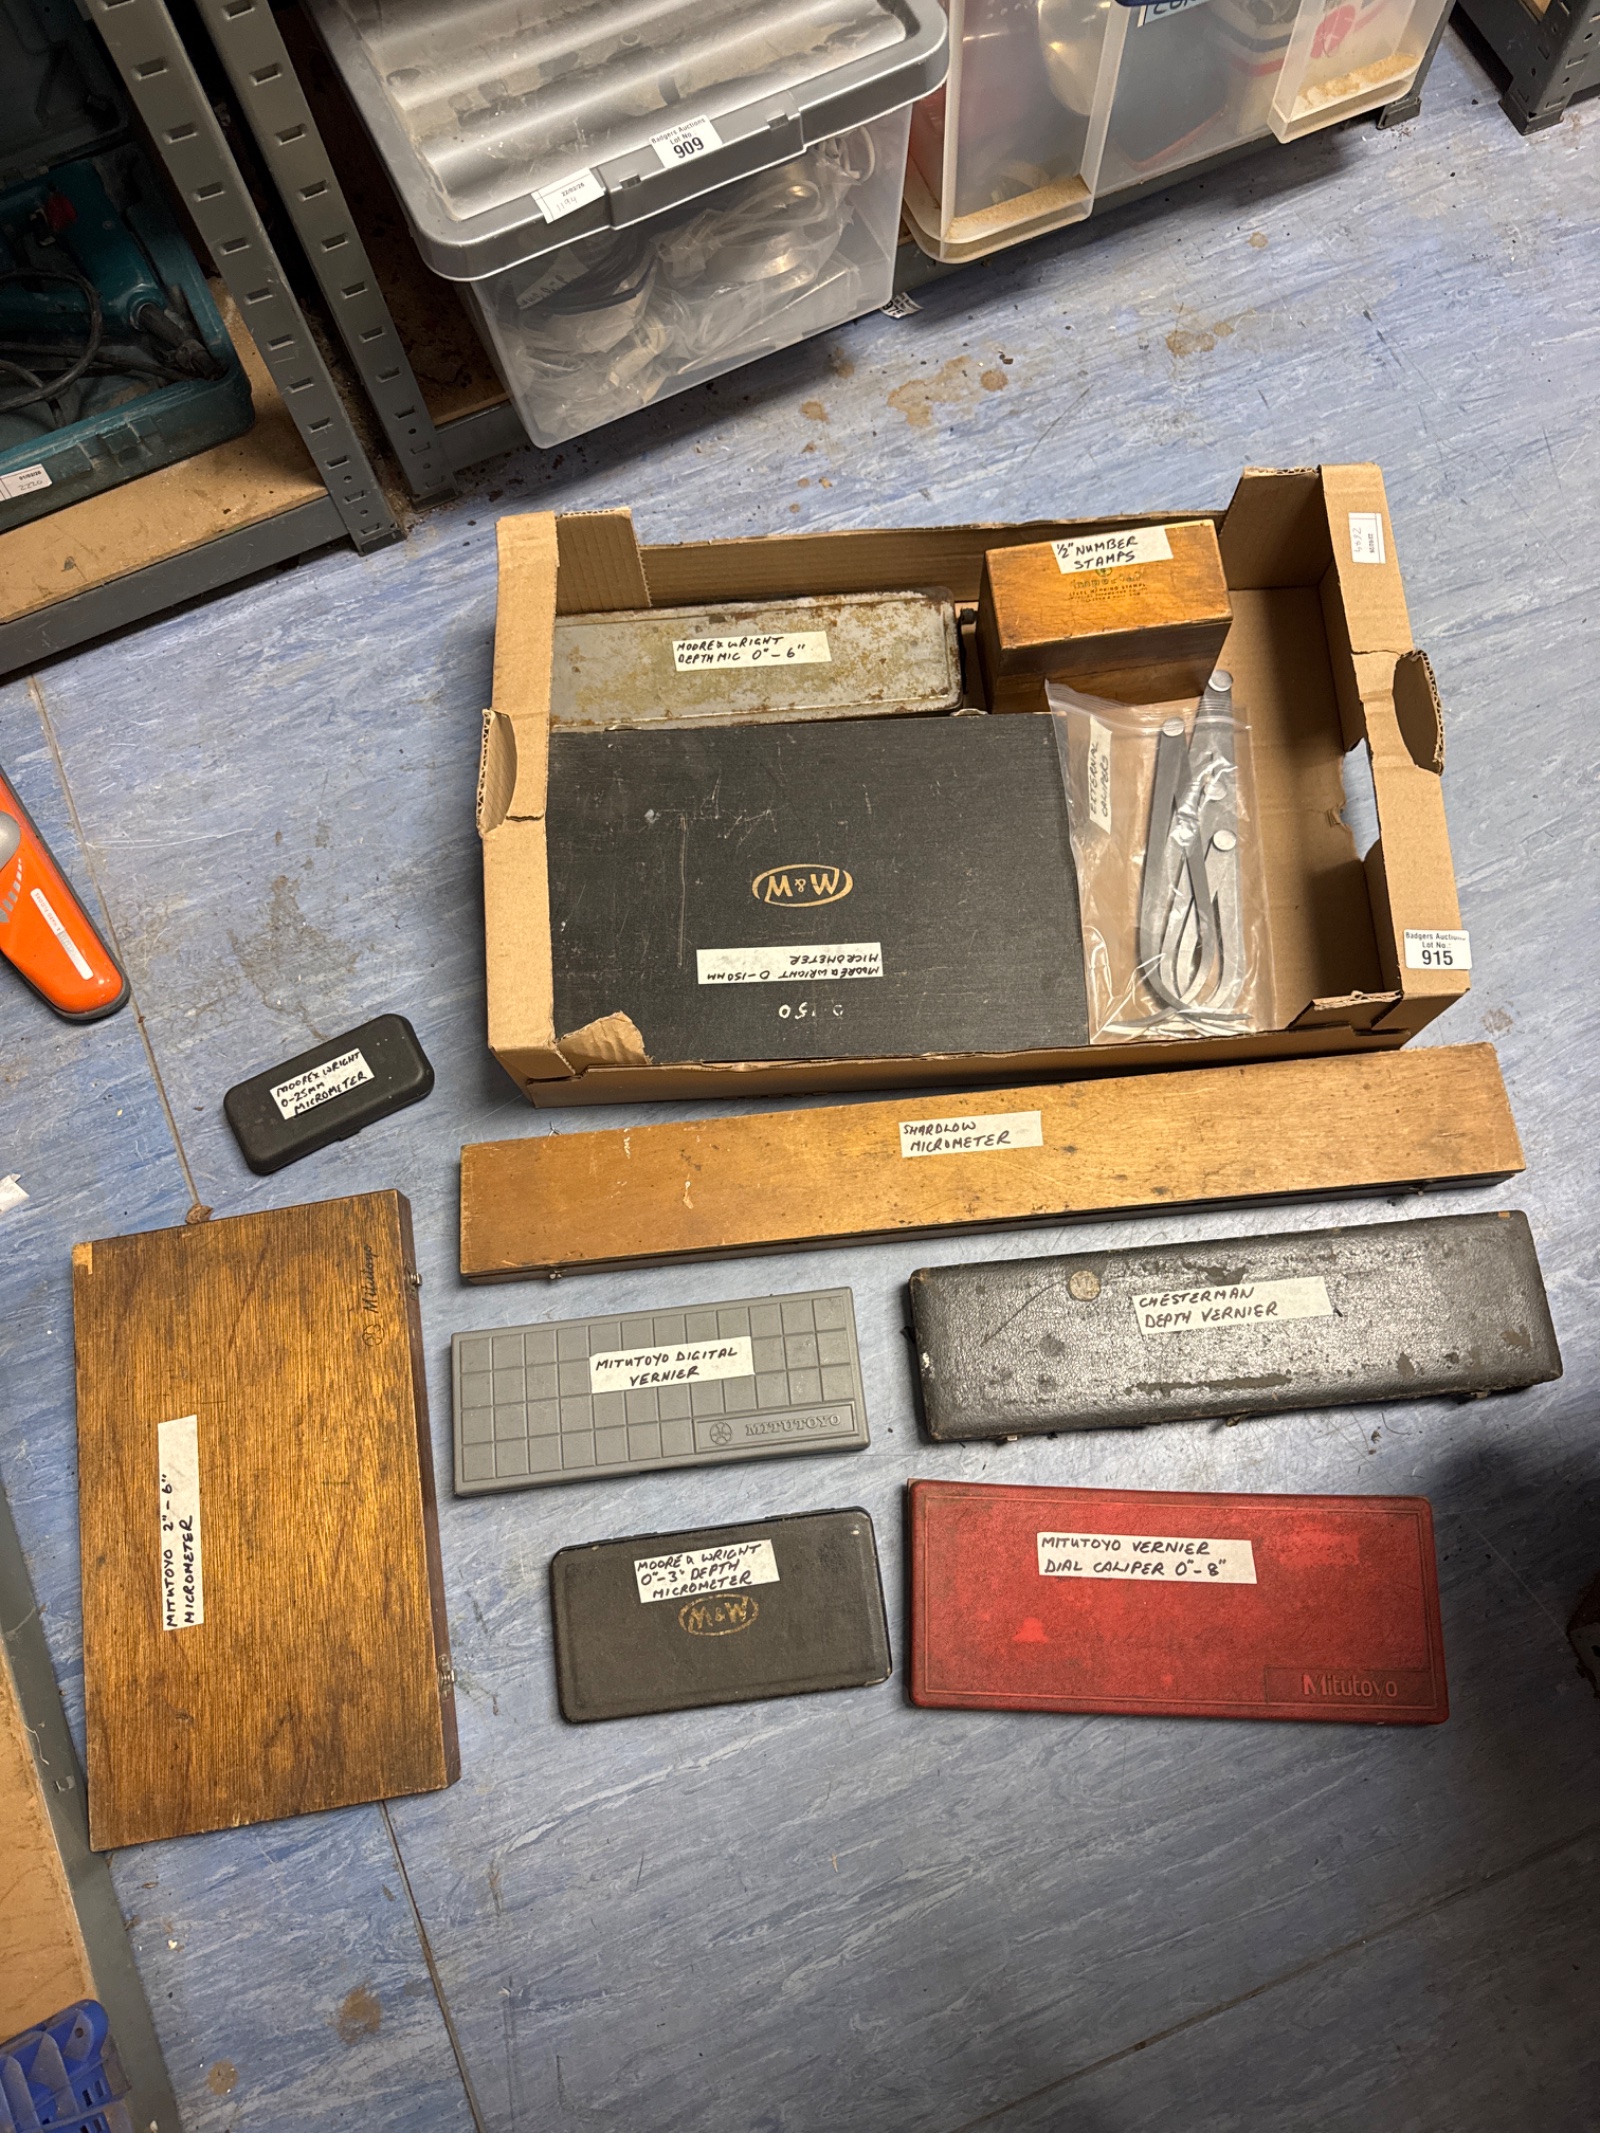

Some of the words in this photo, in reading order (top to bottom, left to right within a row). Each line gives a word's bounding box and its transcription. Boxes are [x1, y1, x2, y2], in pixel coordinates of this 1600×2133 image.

[651, 129, 678, 144] Badgers
[678, 117, 706, 132] Auctions
[670, 136, 679, 145] Lot
[673, 137, 705, 159] 909
[1076, 536, 1138, 556] NUMBER
[1074, 550, 1135, 569] STAMPS
[717, 652, 741, 662] MIC
[1405, 931, 1434, 941] Badgers
[789, 953, 879, 966] MICROMETER
[1421, 949, 1454, 966] 915
[778, 968, 828, 980] WRIGHT
[839, 966, 880, 979] MOORE
[293, 1070, 368, 1118] MICROMETER
[903, 1121, 977, 1136] SHARDLOW
[910, 1130, 1011, 1153] MICROMETER
[360, 1243, 380, 1314] Mitutoyo
[1138, 1286, 1255, 1309] CHESTERMAN
[1144, 1310, 1192, 1329] DEPTH
[1201, 1300, 1279, 1323] VERNIER
[595, 1352, 670, 1372] MITUTOYO
[675, 1347, 738, 1363] DIGITAL
[629, 1365, 700, 1387] VERNIER
[744, 1414, 842, 1437] MITUTOYO
[637, 1554, 683, 1571] MOORE
[701, 1543, 762, 1562] WRIGHT
[1041, 1536, 1121, 1552] MITUTOYO
[1132, 1540, 1211, 1556] VERNIER
[178, 1514, 196, 1624] MICROMETER
[690, 1559, 740, 1581] DEPTH
[1044, 1558, 1083, 1574] DIAL
[1093, 1561, 1165, 1576] CALIPER
[164, 1548, 178, 1628] MITUTOYO
[652, 1570, 753, 1599] MICROMETER
[1302, 1673, 1398, 1700] Mitutoyo
